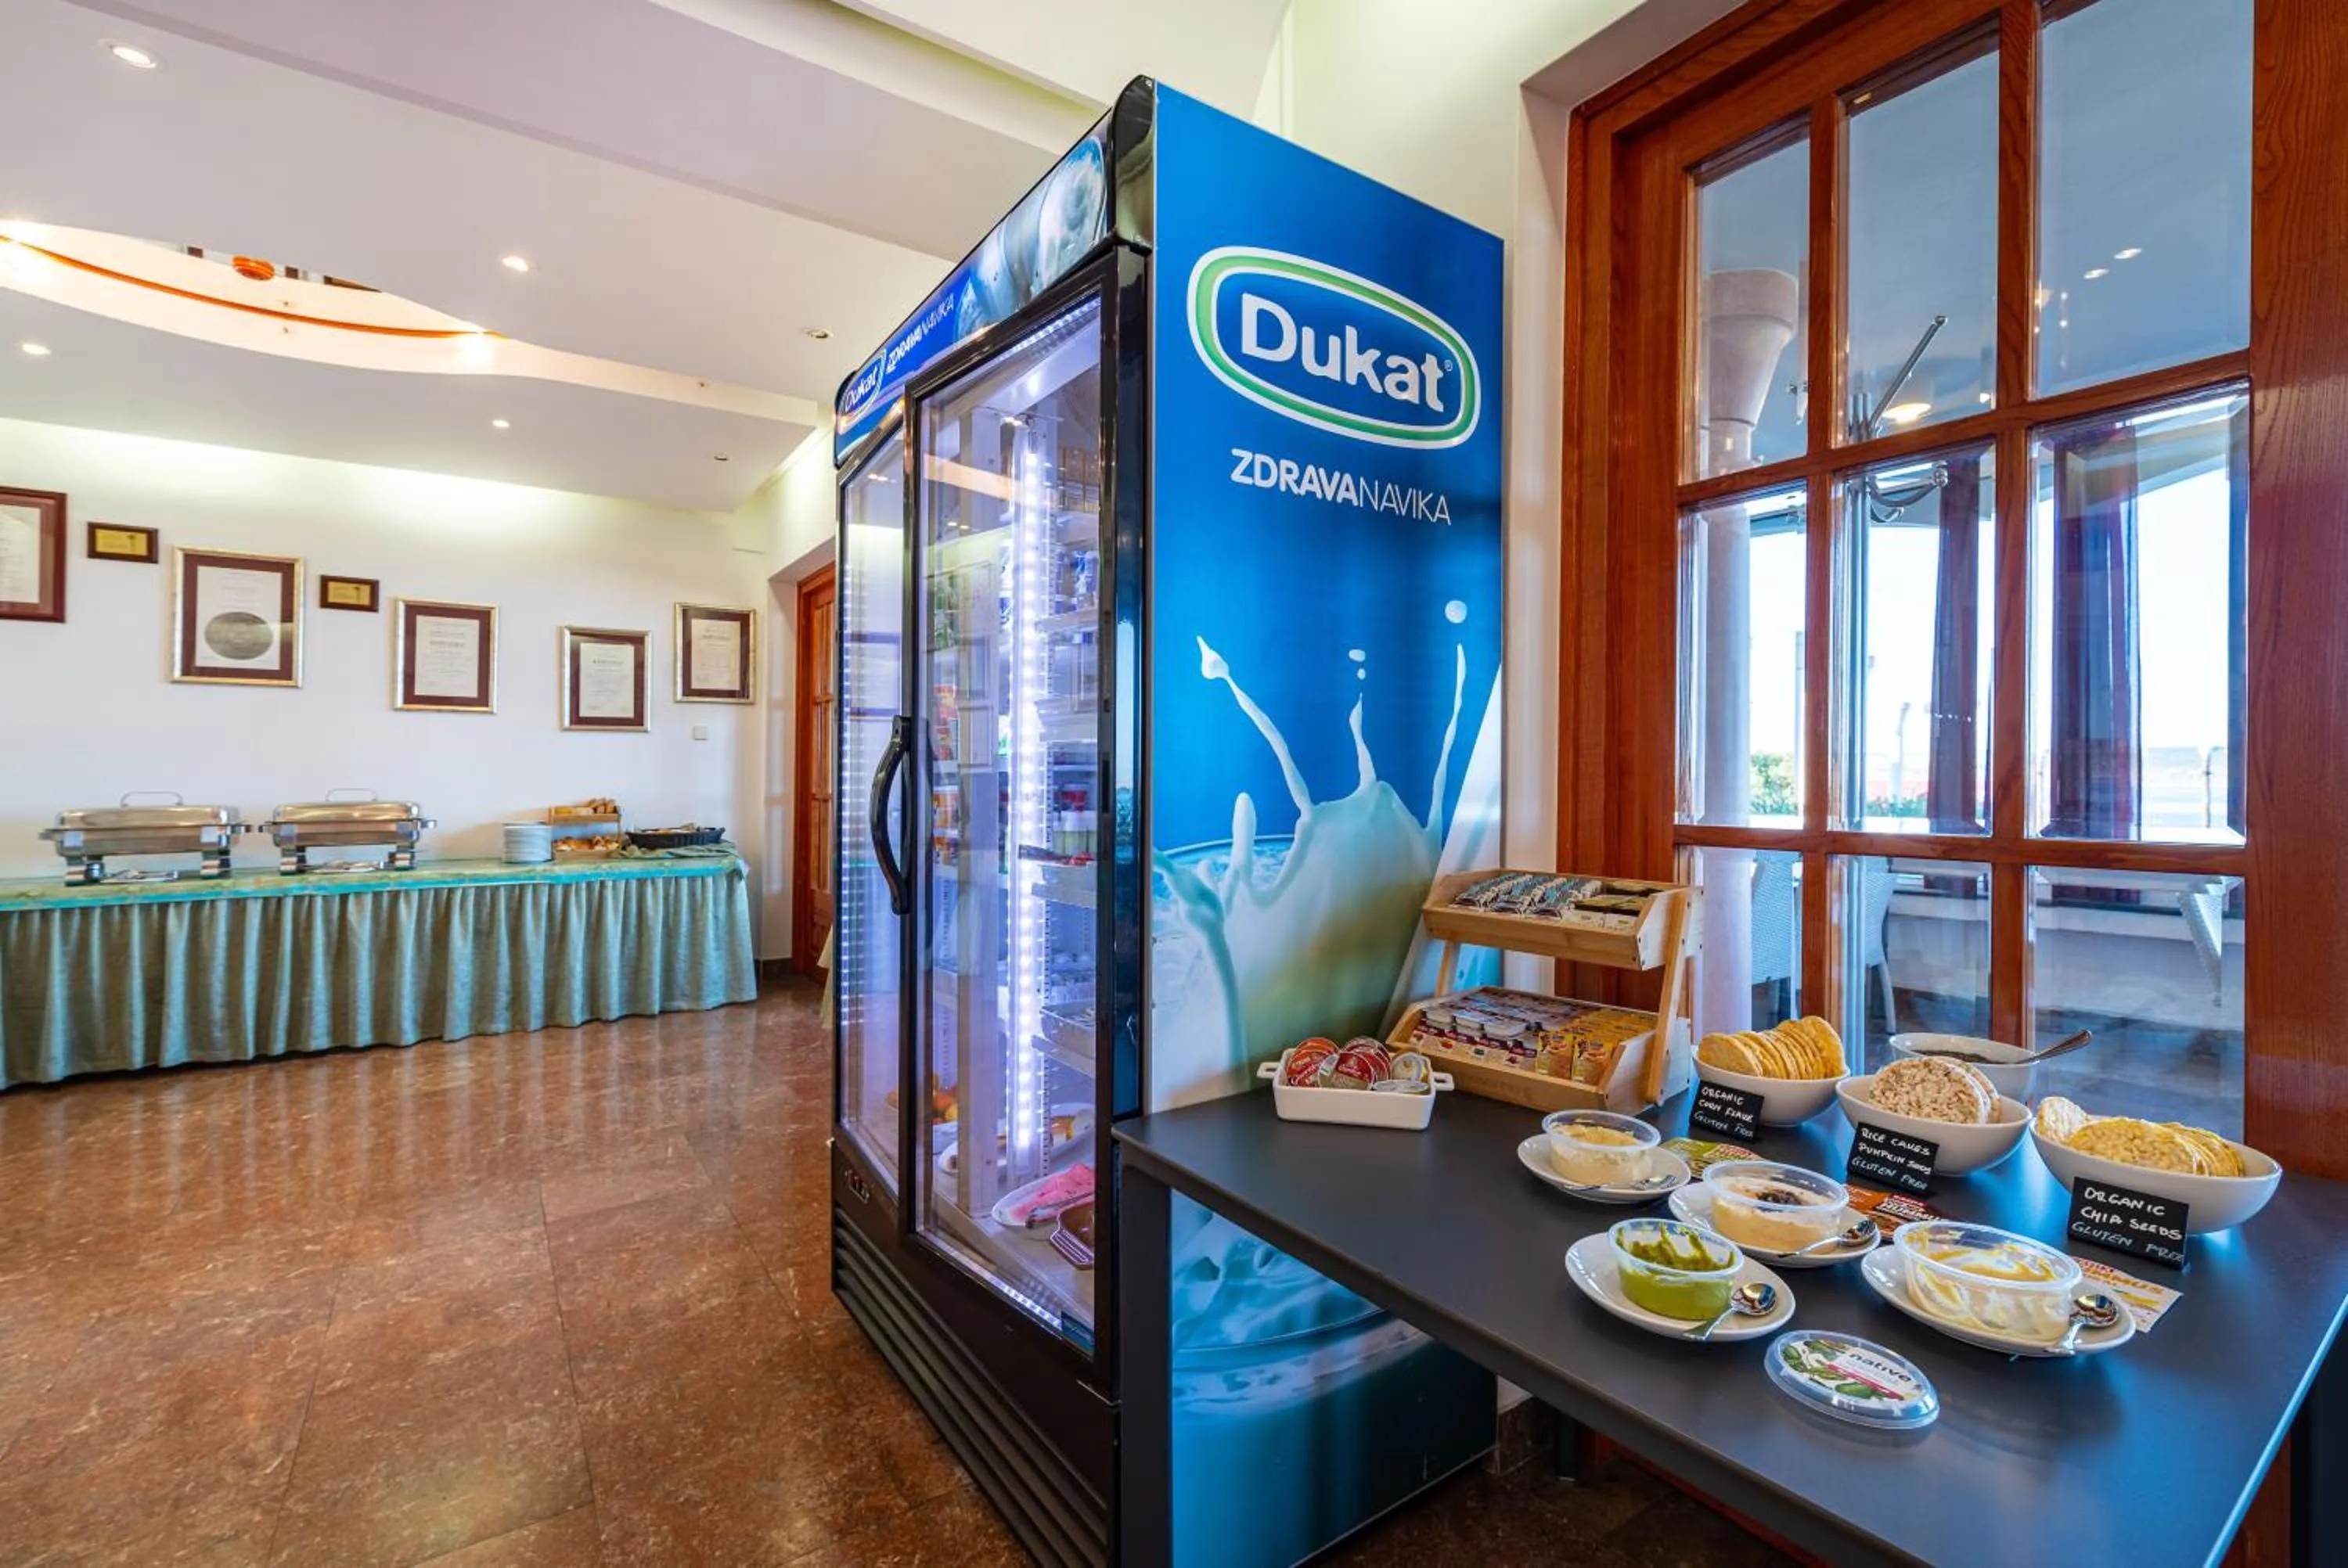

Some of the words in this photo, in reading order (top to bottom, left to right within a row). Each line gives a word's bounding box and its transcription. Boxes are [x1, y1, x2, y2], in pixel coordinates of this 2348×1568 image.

[1241, 293, 1444, 412] Dukat
[844, 365, 878, 412] Dukat
[1702, 1087, 1744, 1106] ORGANIC
[1861, 1127, 1886, 1143] RICE
[1858, 1142, 1906, 1164] PUMPKIN
[1851, 1156, 1897, 1177] GLUTEN
[2083, 1187, 2166, 1216] ORGANIC
[2072, 1221, 2134, 1246] GLUTEN
[2080, 1206, 2123, 1225] CHIA
[2129, 1218, 2183, 1240] SEEDS
